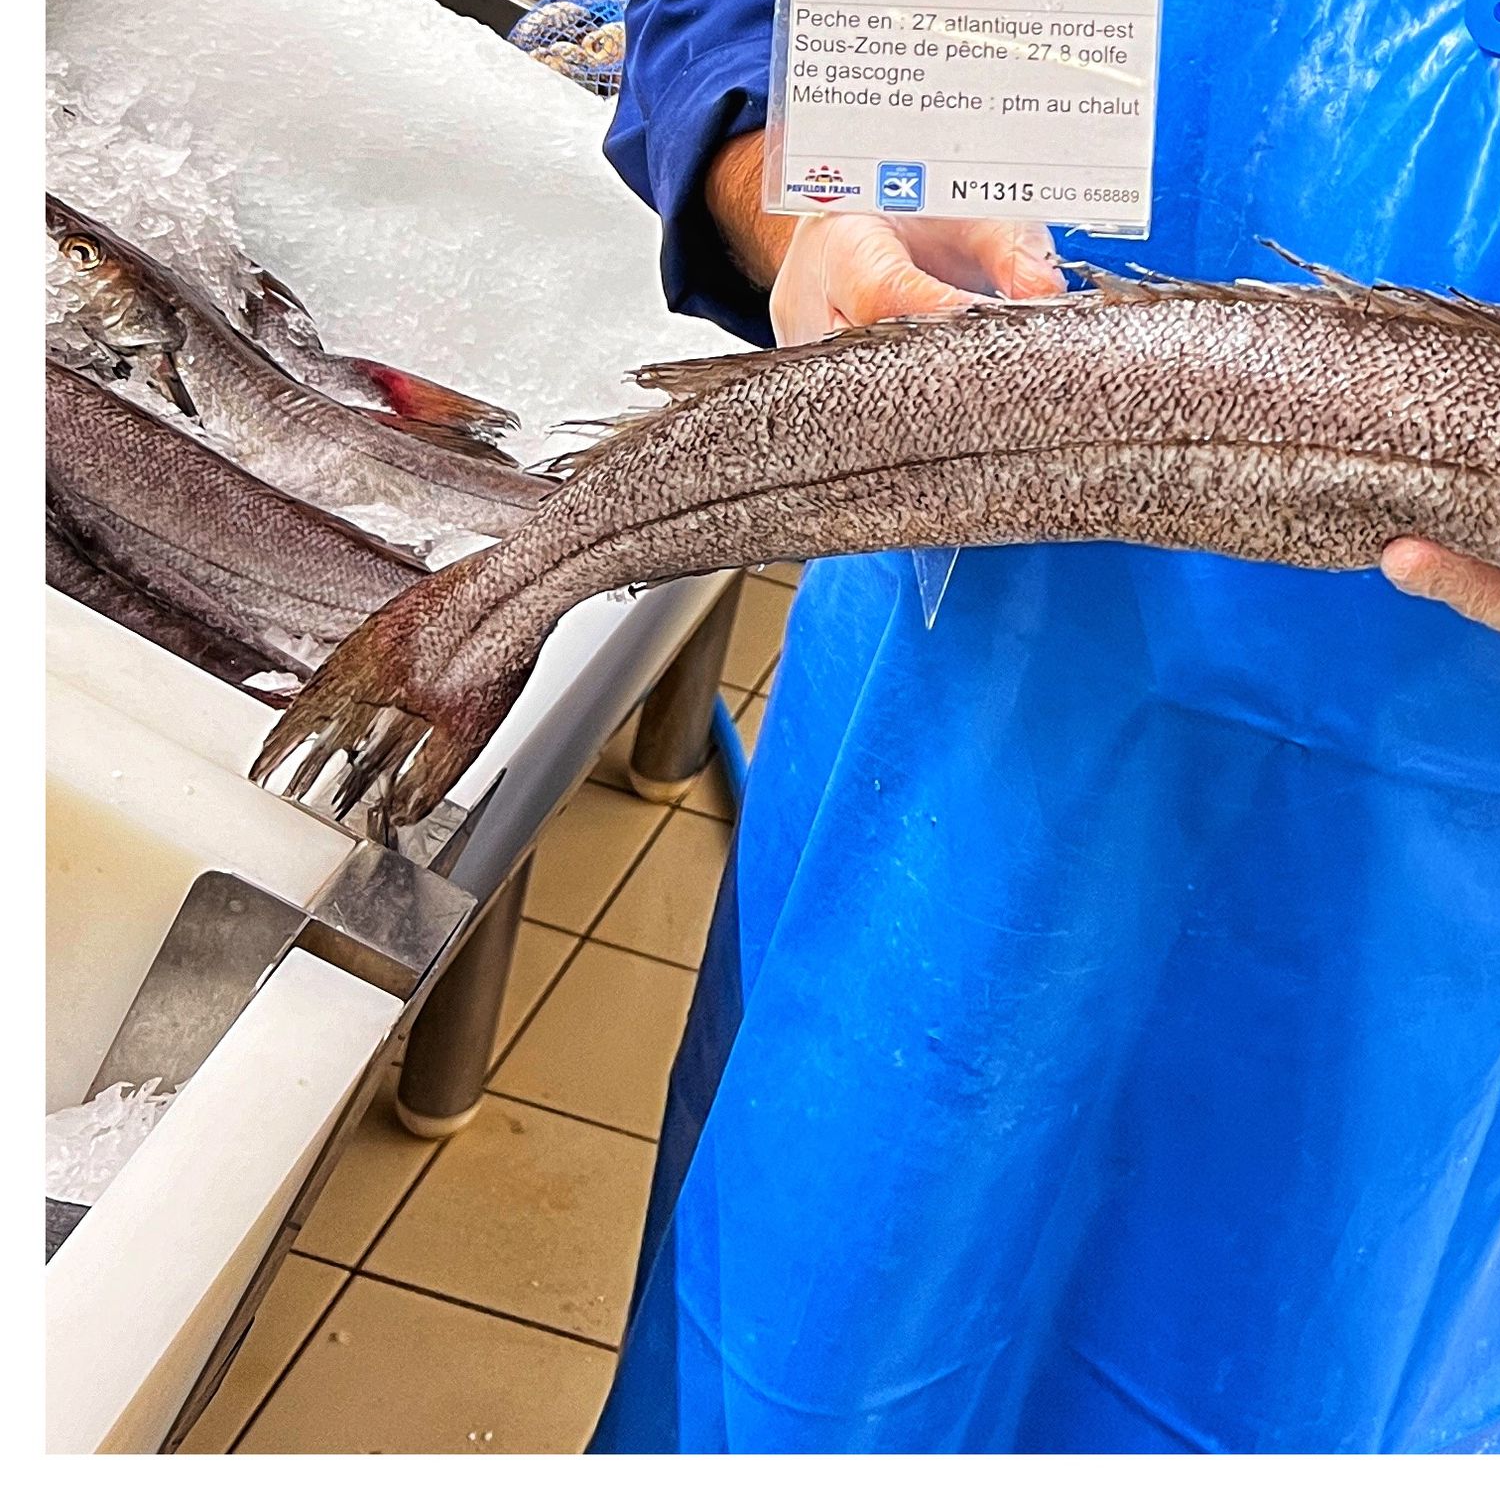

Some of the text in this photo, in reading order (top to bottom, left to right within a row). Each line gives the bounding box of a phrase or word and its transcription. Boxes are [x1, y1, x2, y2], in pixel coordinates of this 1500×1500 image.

[796, 9, 861, 29] Peche
[868, 15, 892, 30] en
[912, 13, 937, 31] 27
[944, 14, 1043, 37] atlantique
[1050, 20, 1135, 39] nord-est
[794, 34, 907, 56] Sous-Zone
[914, 37, 938, 57] de
[946, 38, 1008, 61] pêche
[1078, 45, 1128, 67] golfe
[794, 60, 925, 84] de gascogne
[793, 85, 882, 106] Méthode
[888, 88, 913, 107] de
[920, 90, 982, 112] pêche
[1002, 96, 1040, 115] ptm
[1047, 99, 1072, 114] au
[1079, 95, 1141, 117] chalut
[786, 184, 860, 195] PAVILLON FRANCE
[951, 180, 1140, 203] N°1315 CUG 658889
